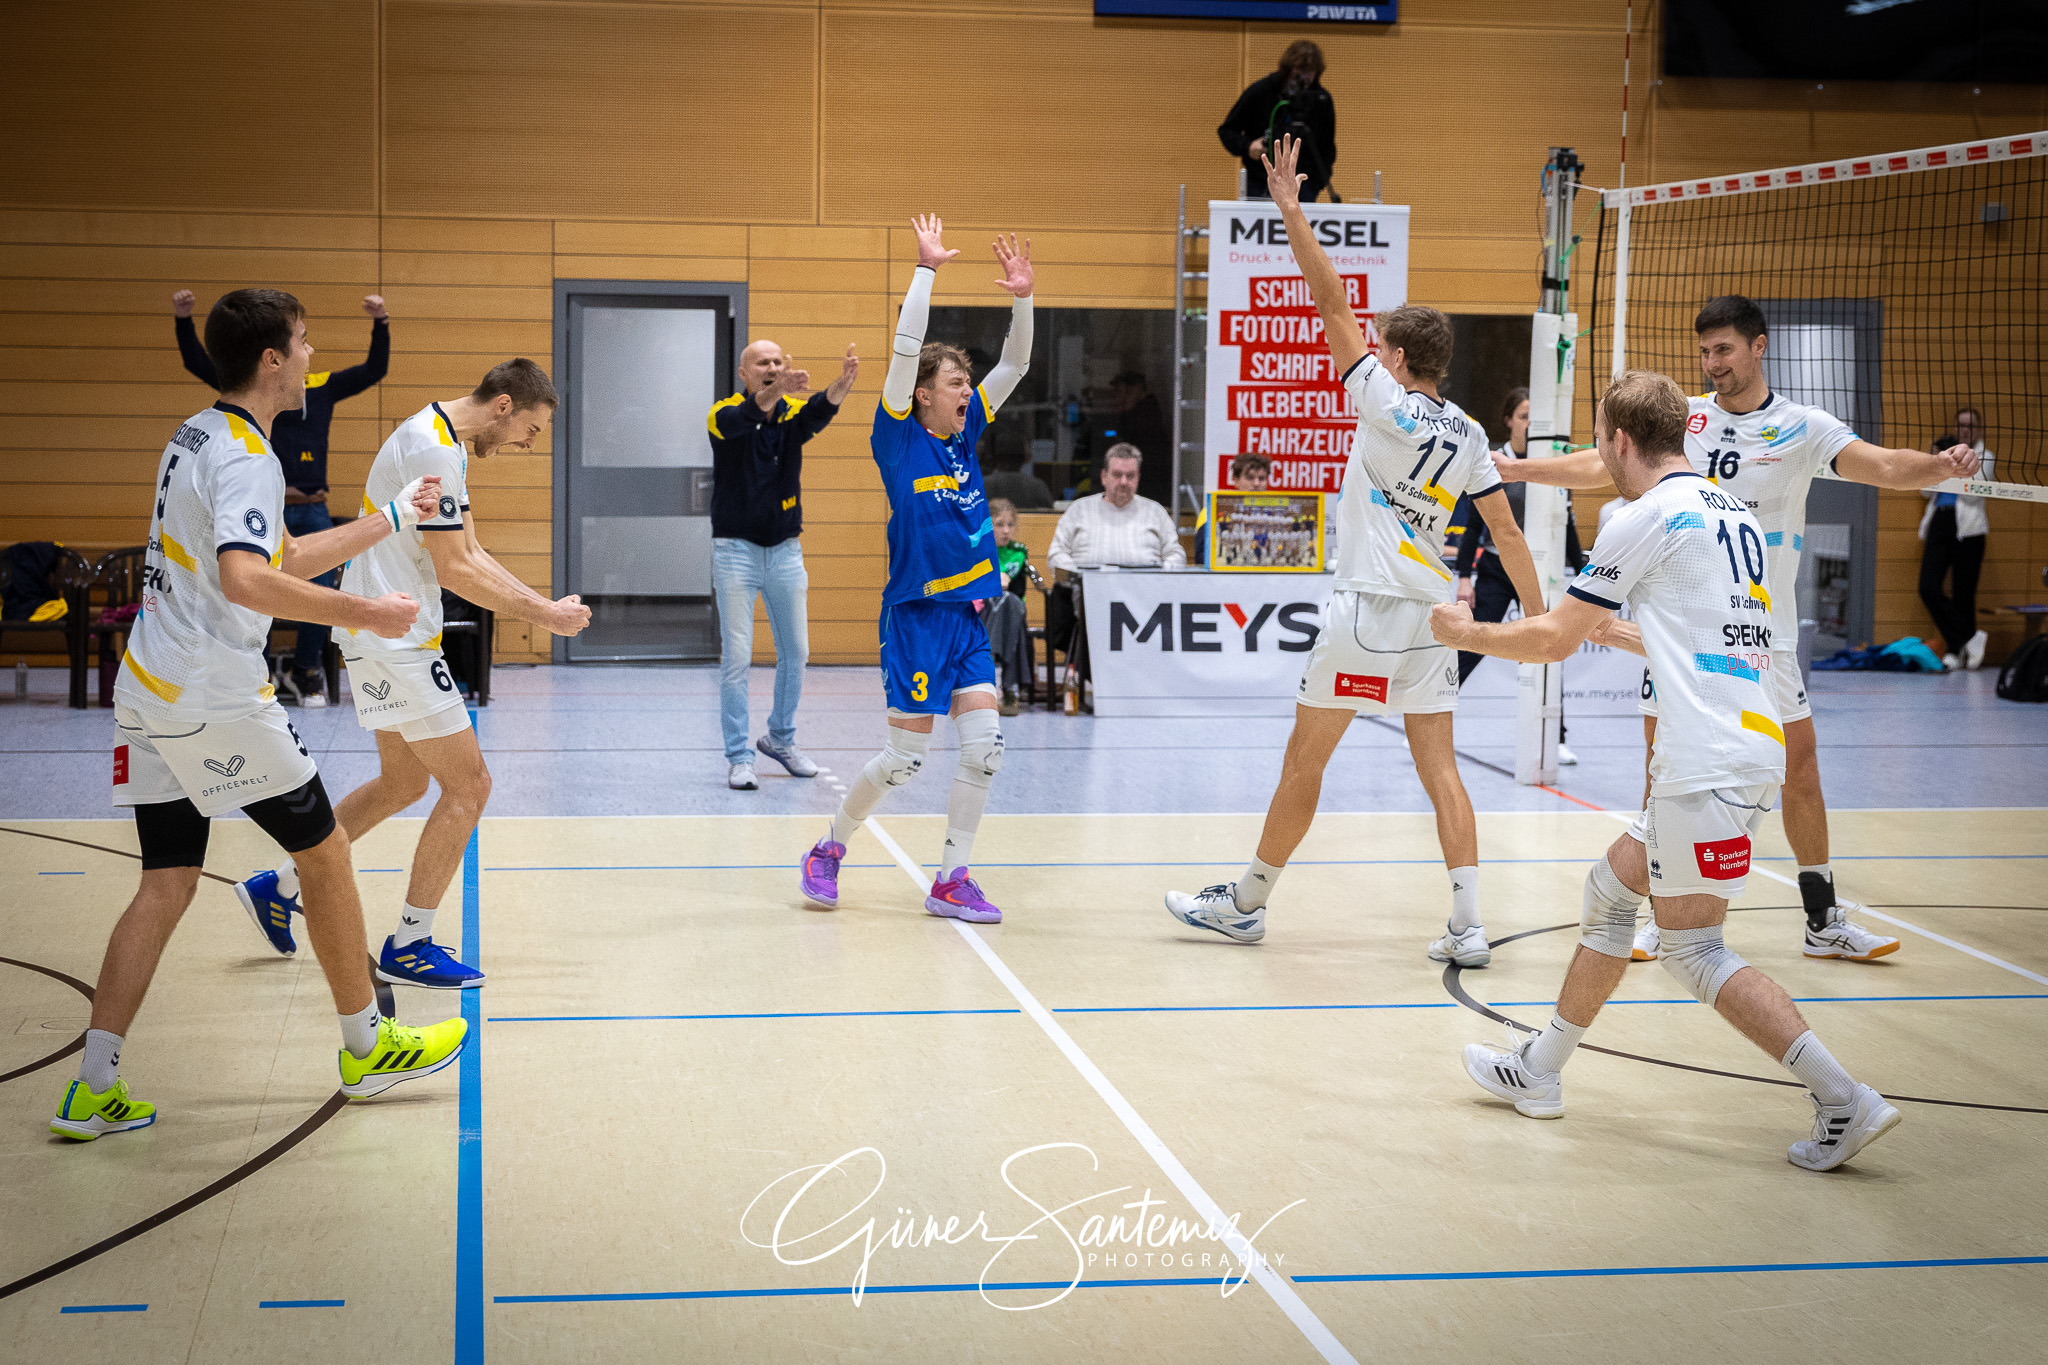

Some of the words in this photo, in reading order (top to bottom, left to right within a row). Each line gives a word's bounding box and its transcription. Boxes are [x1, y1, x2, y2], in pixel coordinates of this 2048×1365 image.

[1306, 5, 1377, 20] PEWETA
[1230, 217, 1389, 248] MESEL
[1229, 251, 1271, 264] Druck
[1255, 278, 1360, 308] SCHILR
[1230, 314, 1378, 344] FOTOTAPN
[1250, 351, 1338, 382] SCHRIFT
[1408, 435, 1458, 488] 17
[1707, 448, 1741, 480] 16
[156, 454, 180, 521] 5
[1395, 481, 1409, 492] SV
[1408, 486, 1439, 507] Schwaig
[1717, 519, 1763, 586] 10
[1591, 565, 1622, 581] puls
[1110, 602, 1321, 653] MEYS
[430, 660, 453, 692] 6
[911, 671, 929, 702] 3
[1352, 682, 1381, 691] Sparkasse
[202, 775, 269, 797] OFFICEWELT
[1718, 849, 1749, 861] Sparkasse
[1719, 858, 1748, 871] Nürnberg
